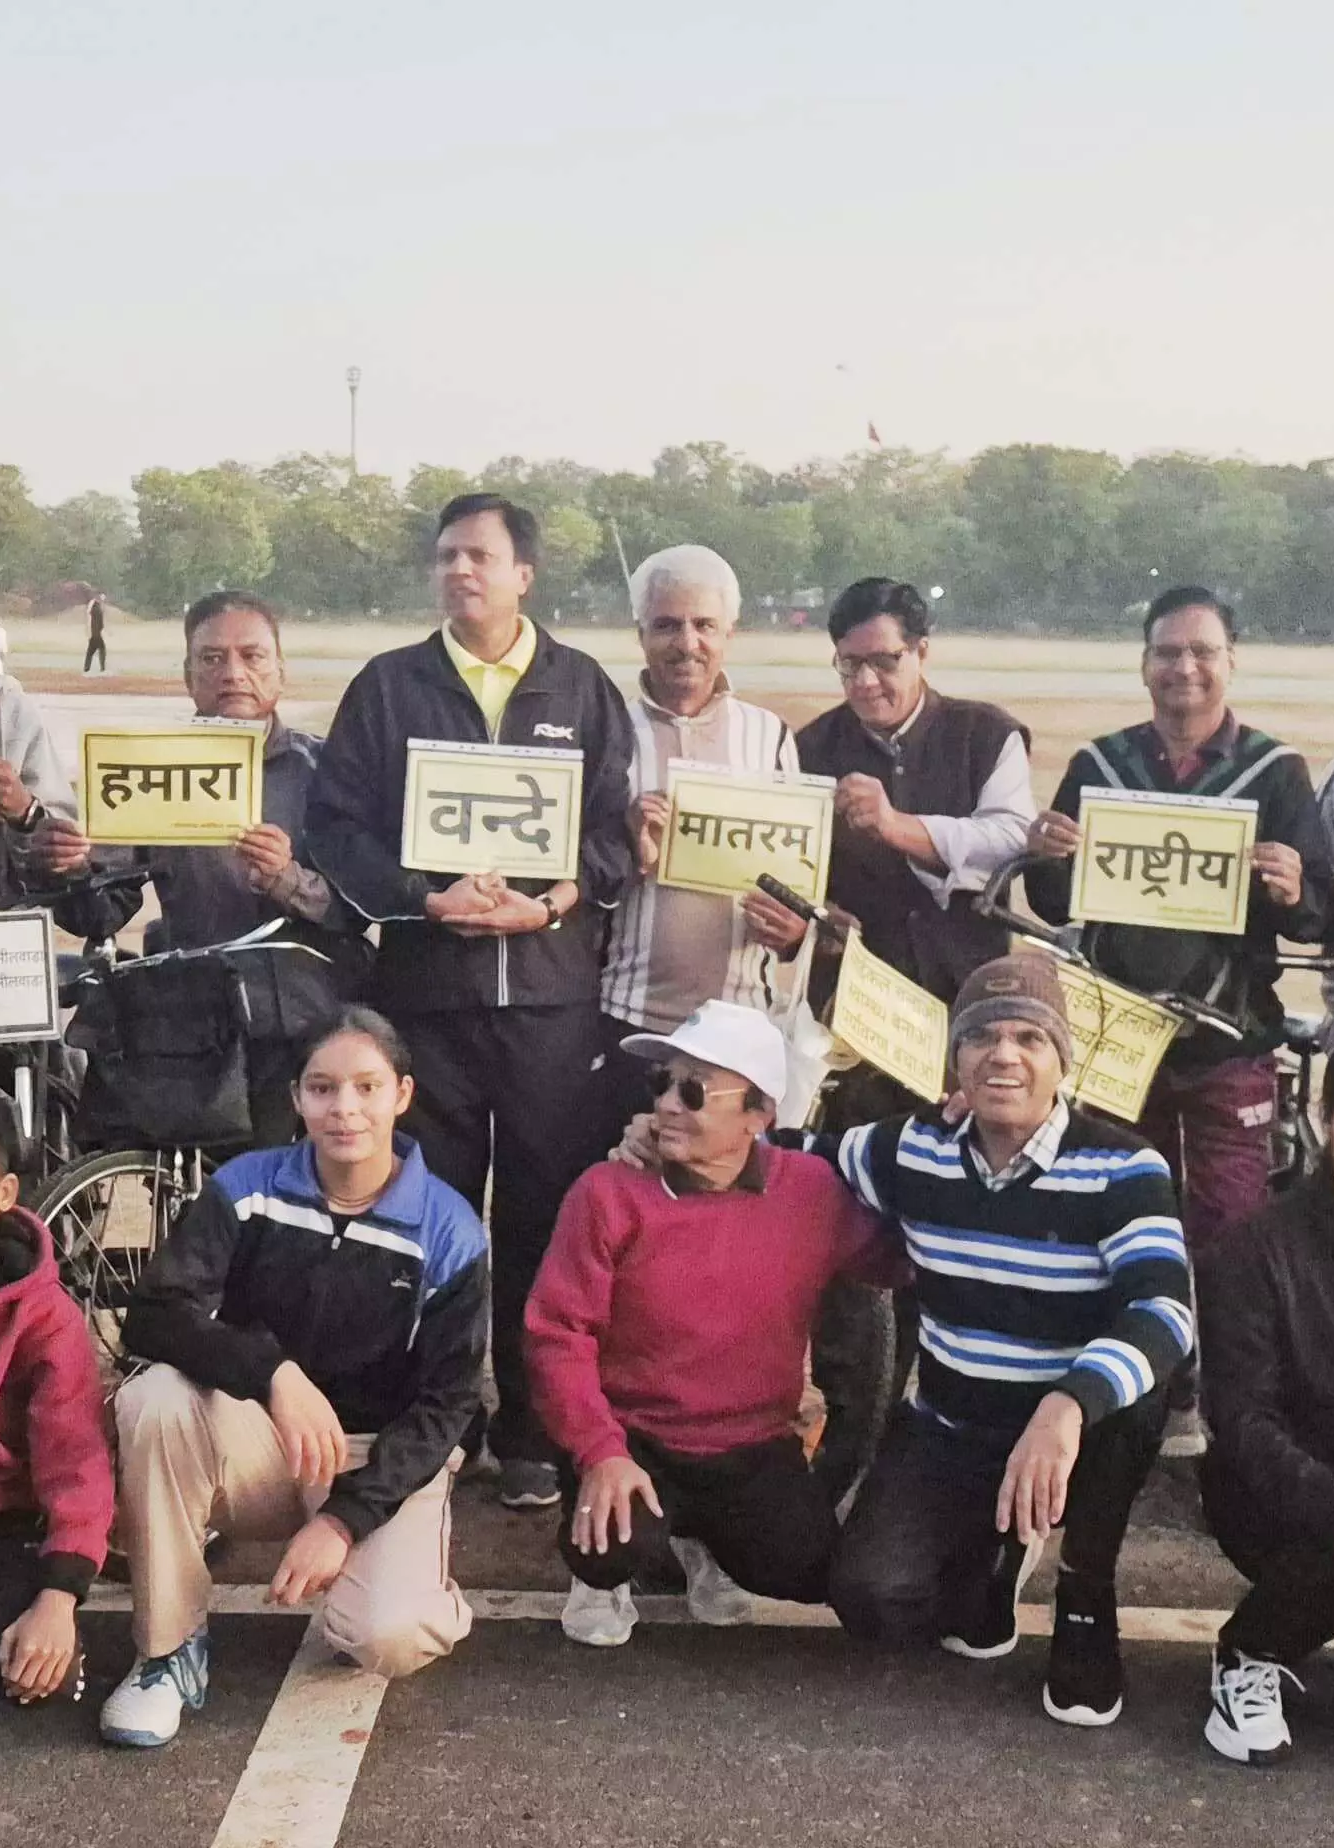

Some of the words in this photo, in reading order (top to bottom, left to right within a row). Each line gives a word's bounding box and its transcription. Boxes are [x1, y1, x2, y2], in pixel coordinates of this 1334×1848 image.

[97, 762, 243, 810] हमारा
[427, 774, 558, 854] वन्दे
[678, 811, 816, 870] मातरम्
[1095, 831, 1236, 898] राष्ट्रीय
